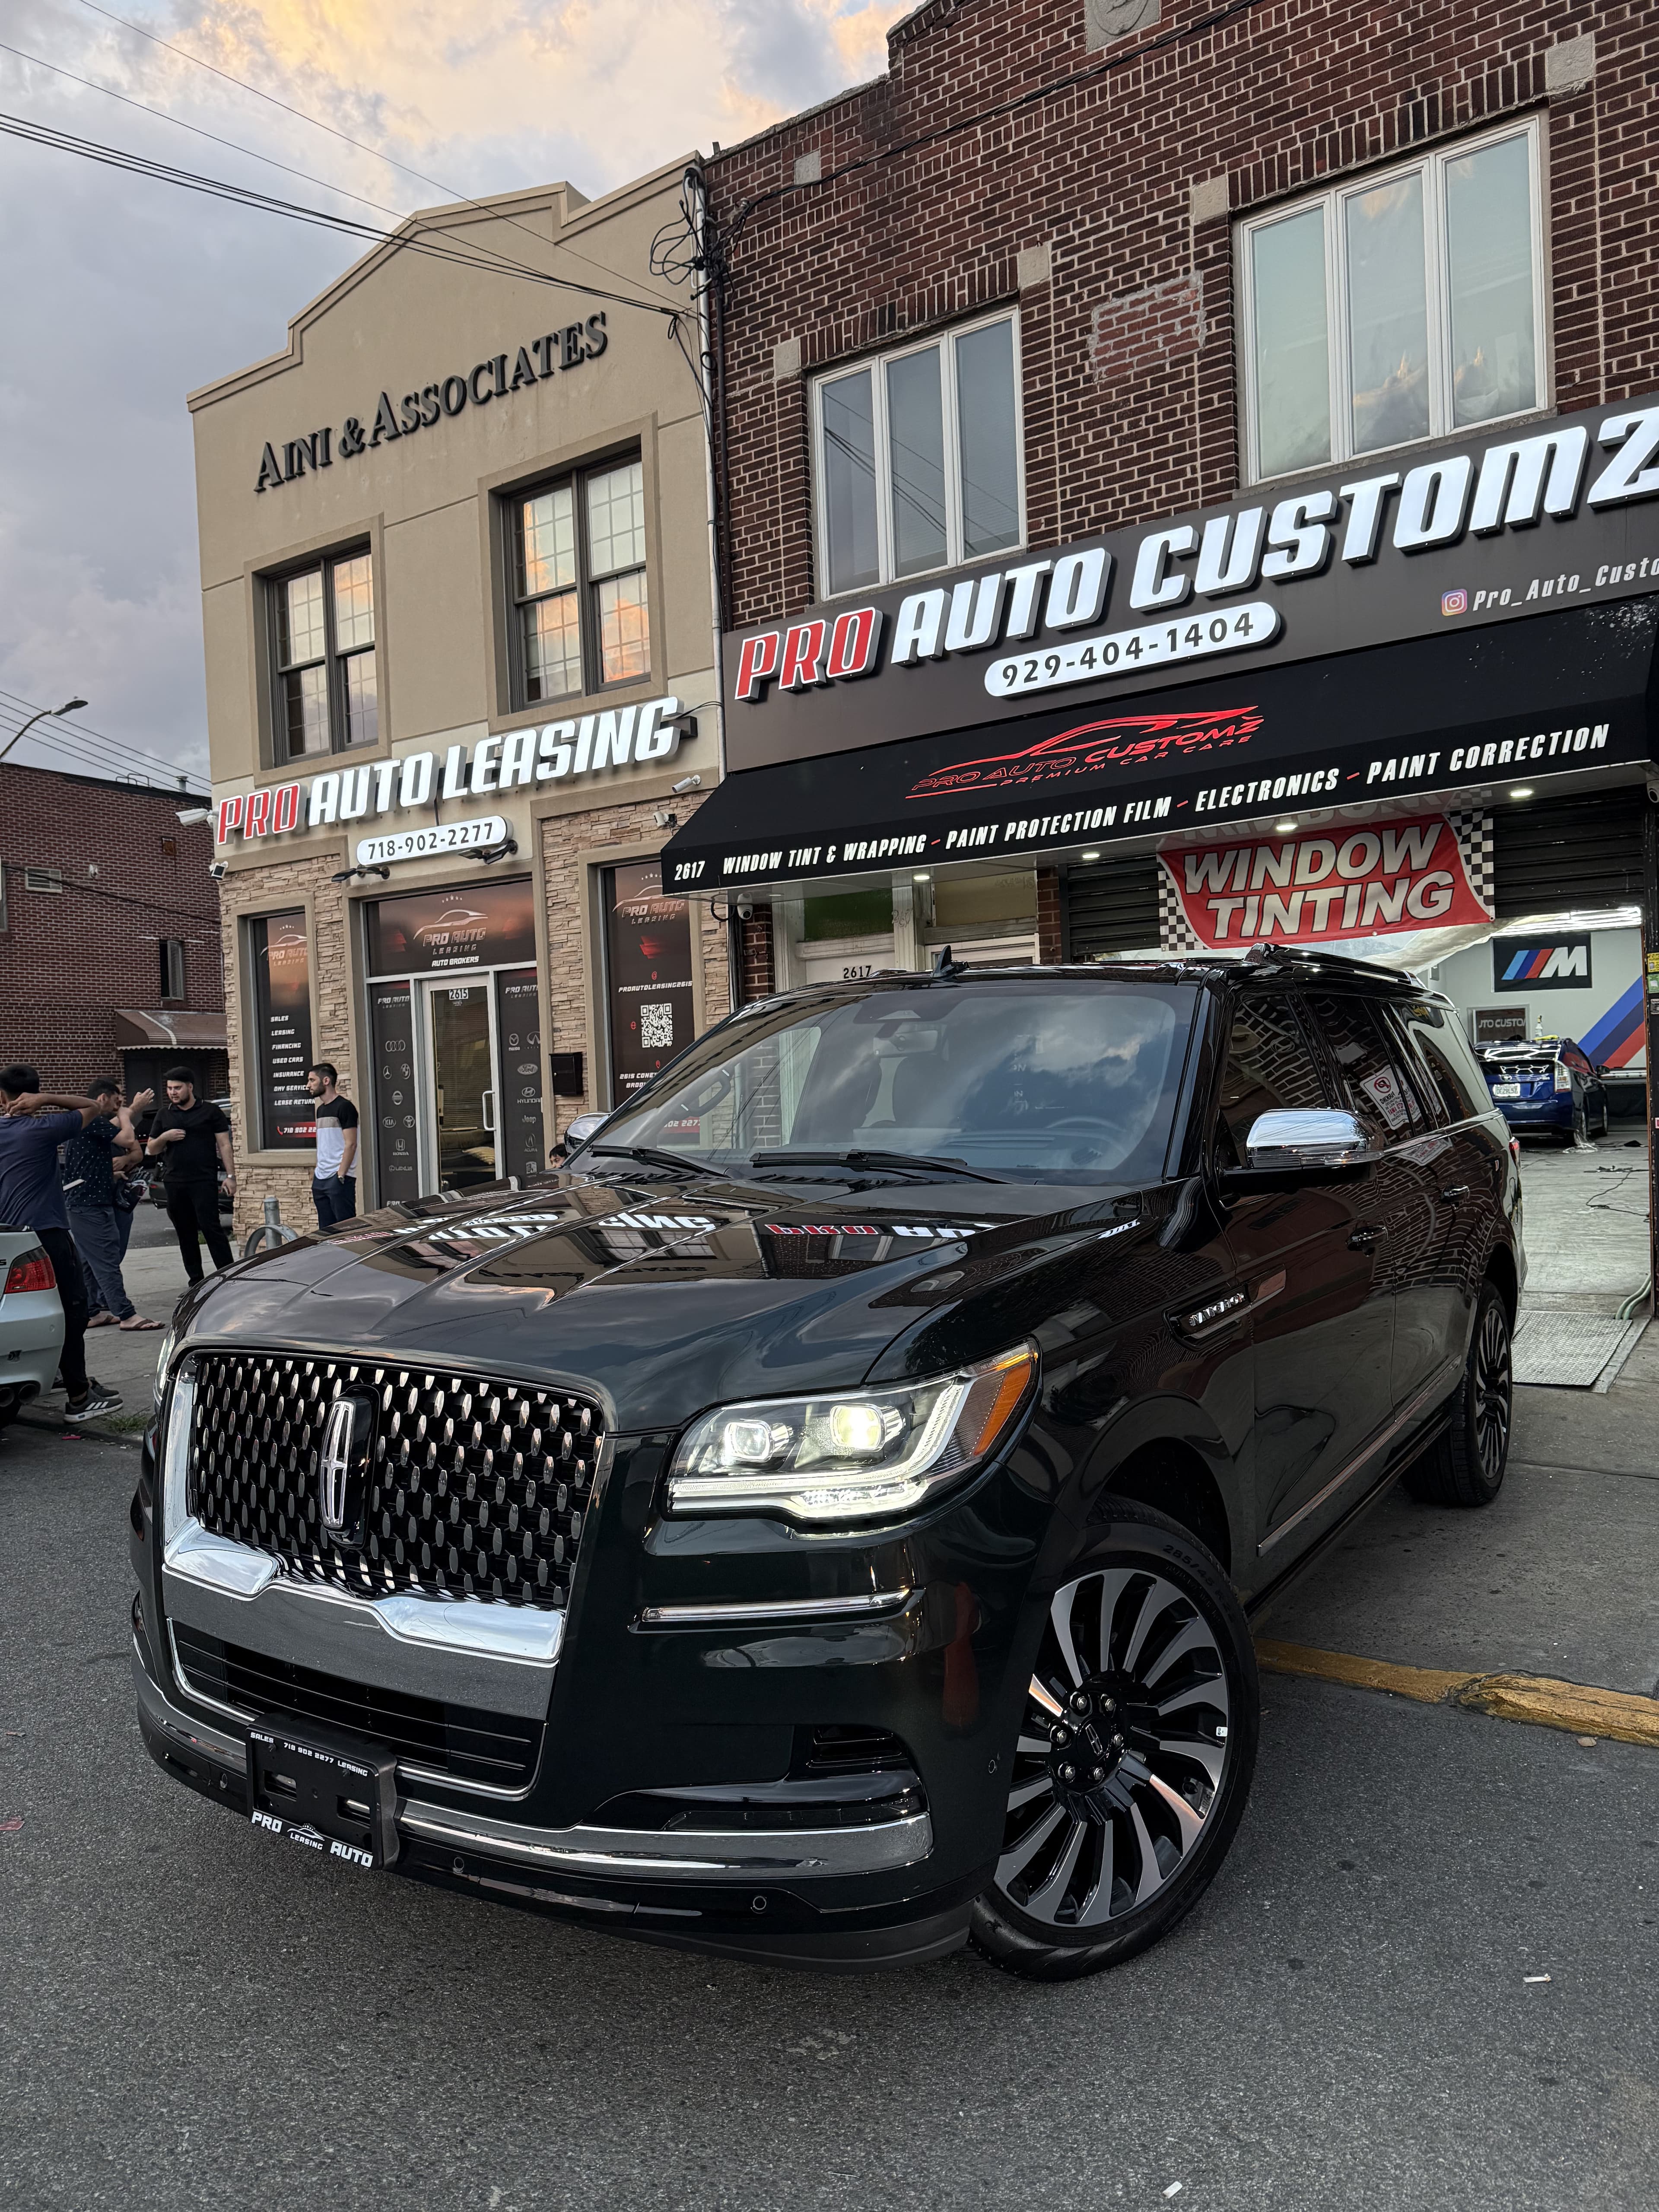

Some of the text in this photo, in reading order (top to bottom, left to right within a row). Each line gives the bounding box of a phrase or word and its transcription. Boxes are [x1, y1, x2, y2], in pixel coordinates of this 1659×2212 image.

[254, 311, 608, 493] AINI & ASSOCIATES
[734, 406, 1659, 703] PRO AUTO CUSTOMZ
[1001, 612, 1255, 688] 929-404-1404
[217, 696, 685, 845] PRO AUTO LEASING
[911, 770, 981, 791] PRO
[982, 756, 1077, 780] AUTO
[1000, 735, 1252, 786] PREMIUM CAR CARE
[674, 861, 705, 881] 2617
[723, 852, 782, 874] WINDOW
[788, 847, 822, 867] TINT
[826, 845, 837, 863] &
[843, 834, 927, 861] WRAPPING
[946, 824, 999, 850] PAINT
[1004, 805, 1117, 841] PROTECTION
[1123, 796, 1172, 823] FILM
[1195, 768, 1339, 812] ELECTRONICS
[1367, 752, 1440, 785] PAINT
[1449, 723, 1610, 772] CORRECTION
[368, 822, 493, 860] 718-902-2277
[1183, 822, 1445, 896] WINDOW
[622, 899, 685, 918] PRO AUTO
[632, 914, 676, 925] LEASING
[1206, 870, 1455, 941] TINTING
[423, 928, 486, 947] PRO AUTO
[432, 944, 477, 955] LEASING
[432, 956, 480, 967] AUTO BROKERS
[843, 965, 872, 979] 2617
[450, 988, 468, 999] 2615
[618, 981, 693, 993] PROAUTOLEASING2615
[1495, 1017, 1526, 1028] CUSTO
[522, 1115, 537, 1124] Jeep
[250, 1732, 368, 1777] SALES 718 902 2277 LEASING
[251, 1811, 373, 1868] PRO AUTO
[290, 1833, 323, 1851] LEASING
